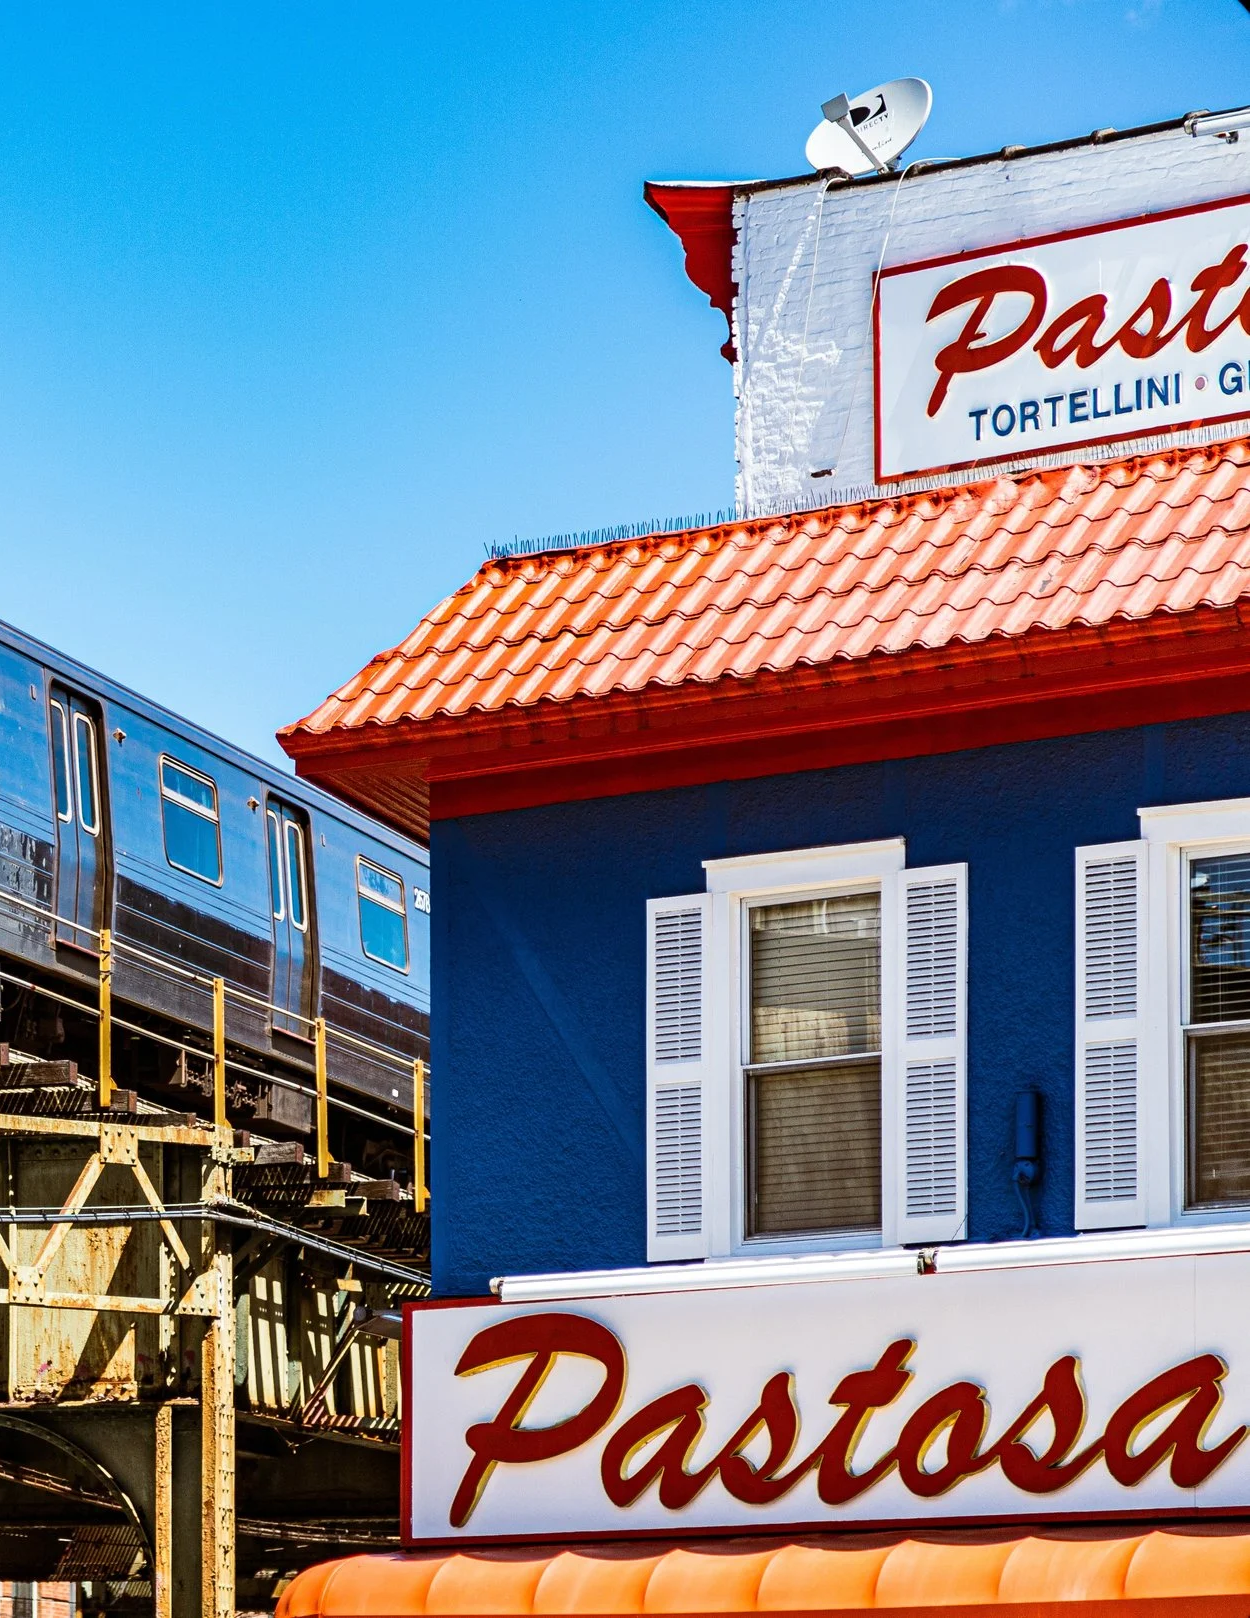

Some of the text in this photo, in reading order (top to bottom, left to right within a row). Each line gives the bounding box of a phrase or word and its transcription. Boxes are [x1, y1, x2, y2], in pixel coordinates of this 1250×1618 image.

[926, 243, 1250, 418] Past
[968, 360, 1250, 440] TORTELLINI G
[449, 1312, 1248, 1529] Pastosa
